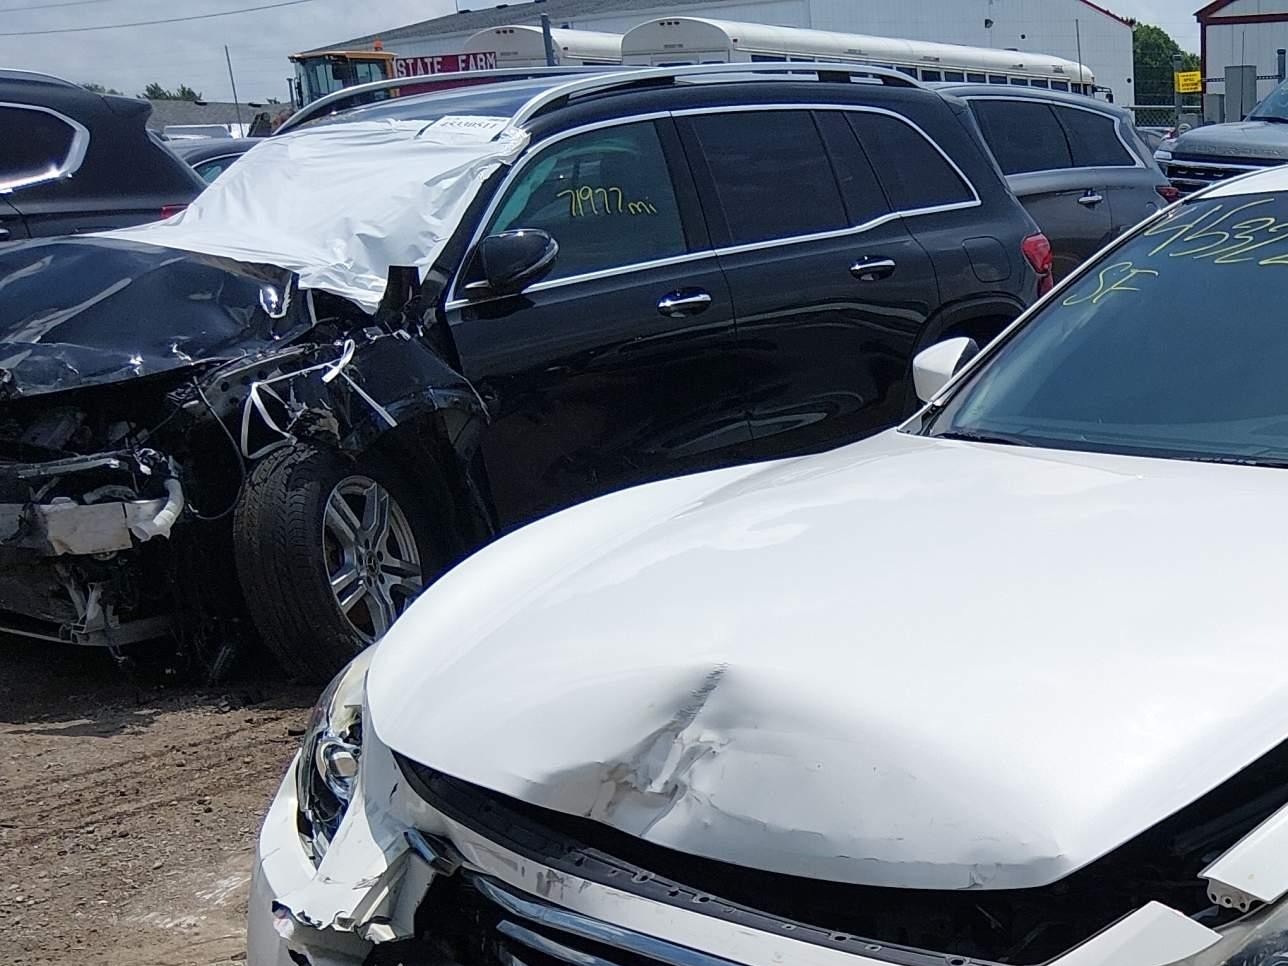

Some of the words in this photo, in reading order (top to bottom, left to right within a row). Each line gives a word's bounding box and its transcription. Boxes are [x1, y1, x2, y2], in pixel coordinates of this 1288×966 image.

[397, 57, 442, 77] STATE
[457, 52, 496, 72] FARM
[556, 185, 623, 217] 71977
[627, 201, 657, 215] mi
